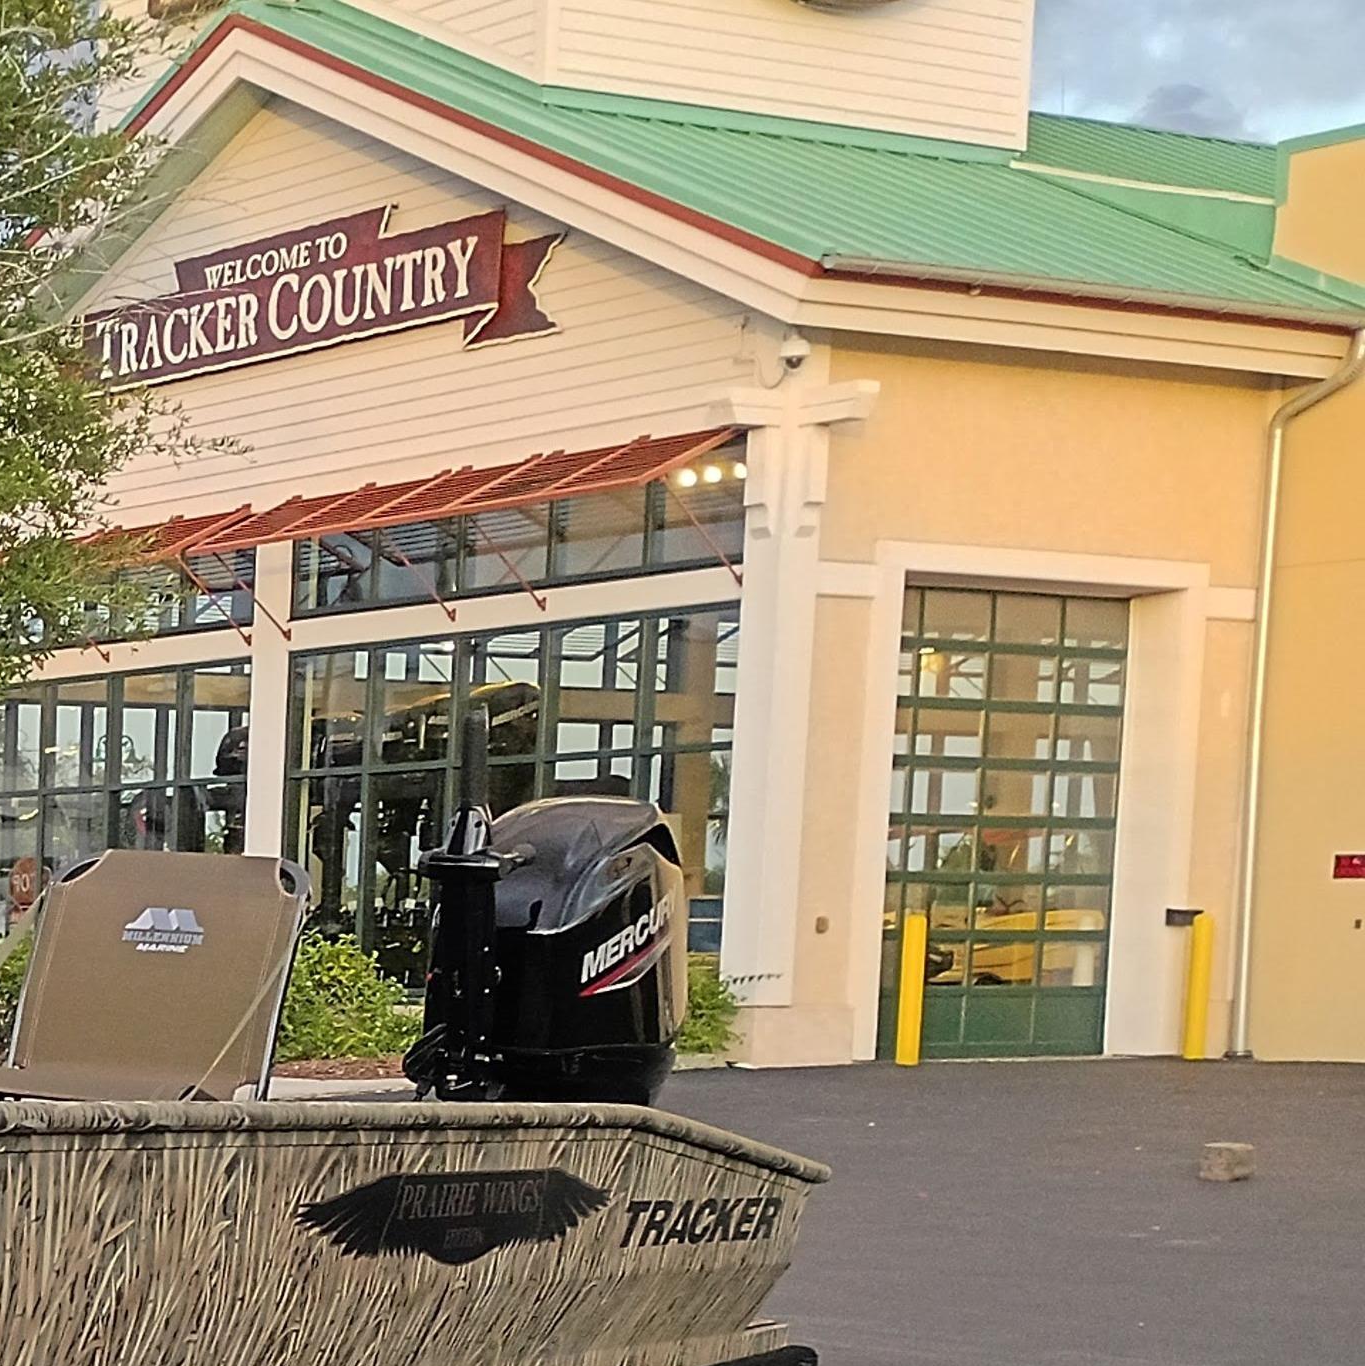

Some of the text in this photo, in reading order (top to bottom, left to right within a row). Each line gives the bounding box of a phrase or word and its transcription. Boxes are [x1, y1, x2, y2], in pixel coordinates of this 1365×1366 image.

[204, 231, 348, 292] WELCOME TO
[96, 235, 479, 381] TRACKER COUNTRY
[134, 942, 189, 953] MARINE
[579, 893, 676, 984] MERCUR
[396, 1178, 544, 1220] PRAIRIE WINGS
[619, 1196, 783, 1249] TRACKER
